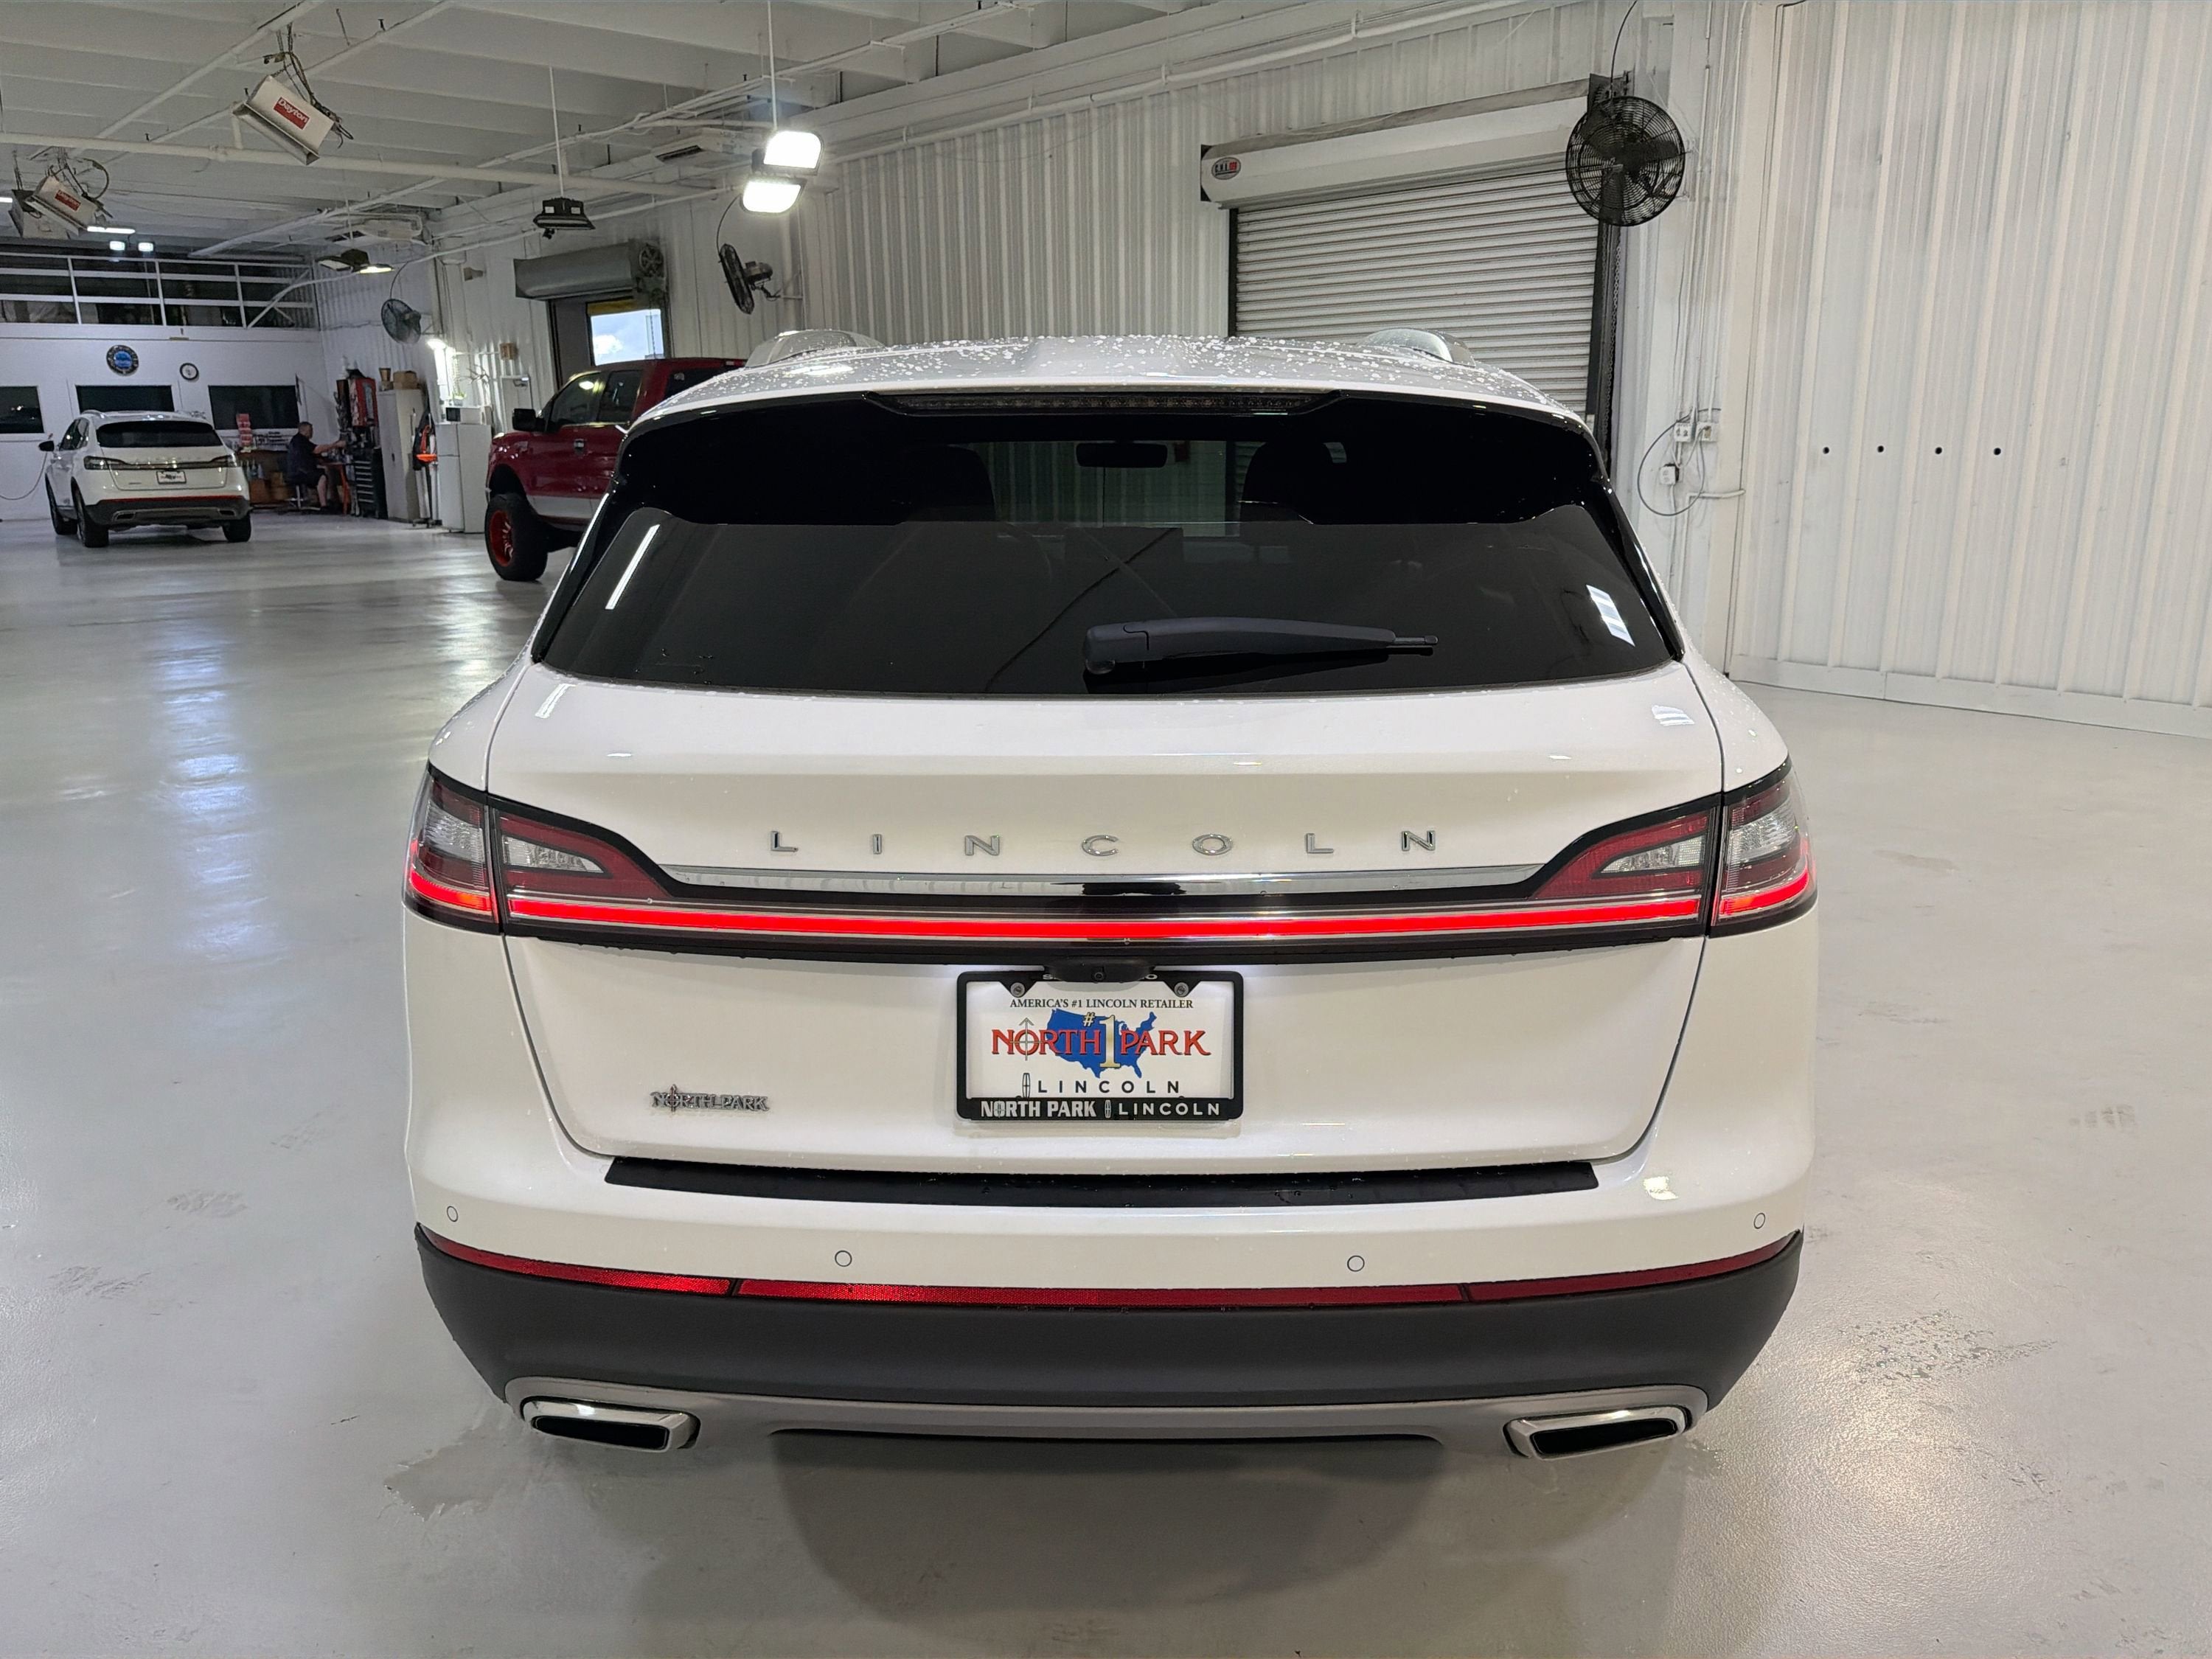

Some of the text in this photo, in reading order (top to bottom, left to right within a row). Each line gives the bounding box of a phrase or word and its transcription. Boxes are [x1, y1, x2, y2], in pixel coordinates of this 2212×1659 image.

[277, 98, 308, 123] Dayton
[769, 830, 1436, 857] LINCOLN
[1009, 998, 1194, 1009] AMERICA'S #1 LINCOLN RETAILER
[991, 1029, 1211, 1056] NORTH PARK
[1037, 1080, 1179, 1093] LINCOLN
[650, 1091, 770, 1112] NORTH PARK
[981, 1100, 1220, 1118] NORTH PARK LINCOLN
